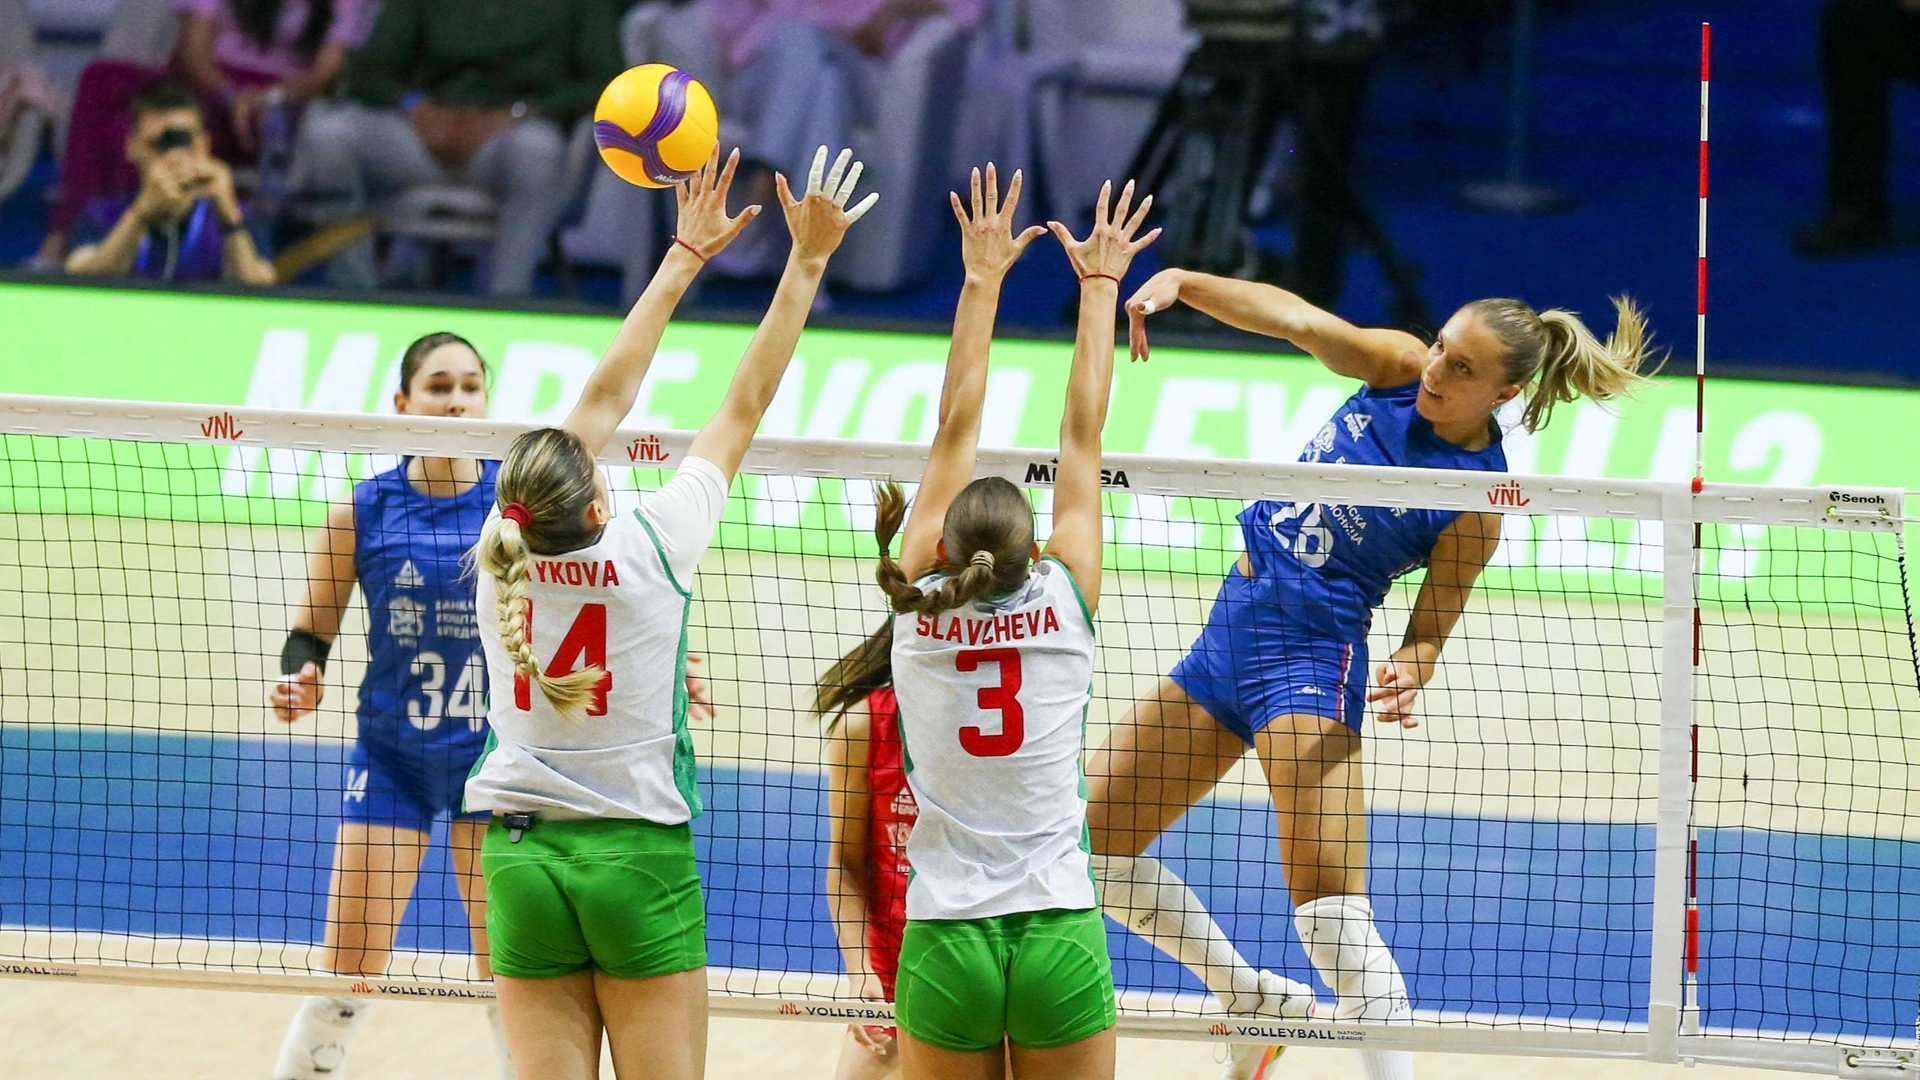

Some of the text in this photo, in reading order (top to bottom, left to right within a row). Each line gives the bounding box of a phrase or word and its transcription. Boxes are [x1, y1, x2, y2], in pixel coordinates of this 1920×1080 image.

[201, 412, 243, 440] VNL
[627, 434, 669, 461] VNL
[1024, 459, 1130, 488] MISA
[1487, 480, 1530, 506] VNL
[1842, 493, 1884, 504] Senoh
[407, 651, 486, 733] 34
[955, 647, 1024, 757] 3
[0, 965, 50, 975] YBALL
[350, 981, 475, 998] VNL VOLLEYBALL
[778, 1003, 895, 1020] VNL VOLLEYBAL
[1208, 1022, 1233, 1037] VNL
[1237, 1026, 1336, 1040] VOLLEYBALL
